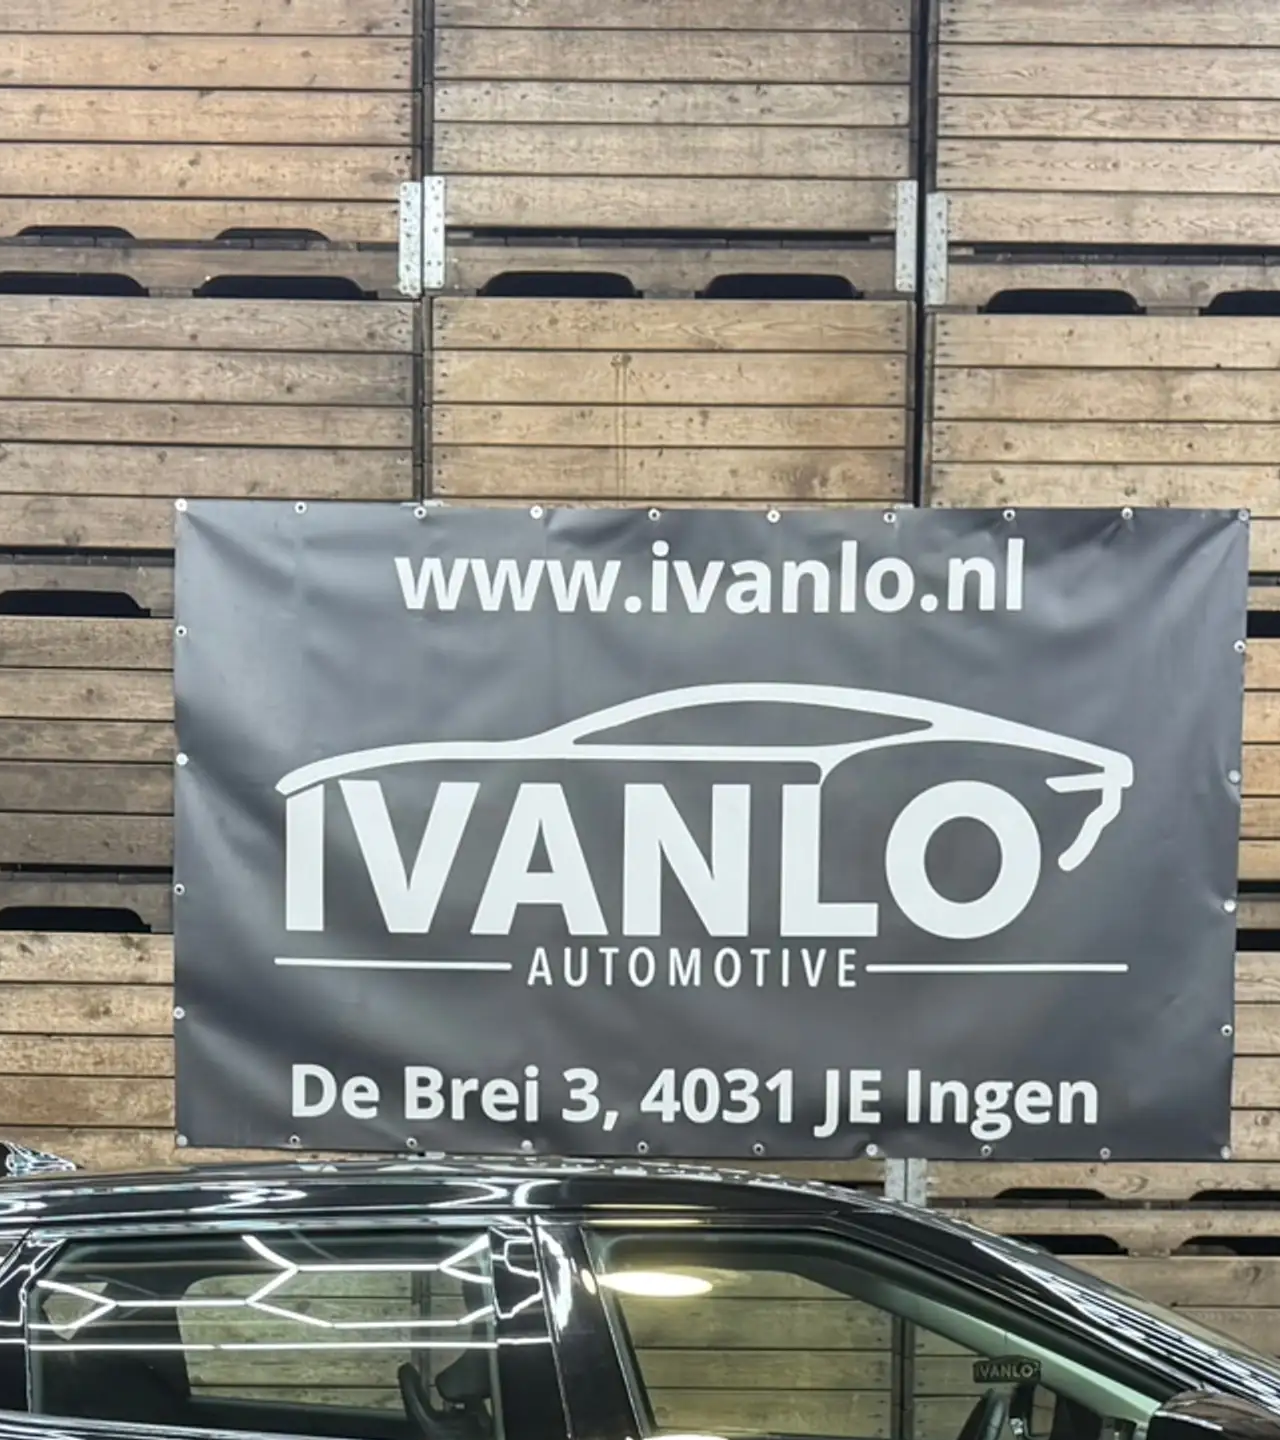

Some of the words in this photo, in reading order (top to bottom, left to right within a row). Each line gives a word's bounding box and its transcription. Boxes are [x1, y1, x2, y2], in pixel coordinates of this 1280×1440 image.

[395, 538, 1025, 615] www.ivanlo.nl
[284, 776, 1042, 940] IVANLO
[527, 946, 858, 989] AUTOMOTIVE
[291, 1063, 380, 1120] De
[404, 1064, 540, 1122] Brei
[562, 1067, 619, 1132] 3,
[640, 1067, 793, 1124] 4031
[814, 1068, 882, 1138] JE
[907, 1069, 1098, 1141] Ingen
